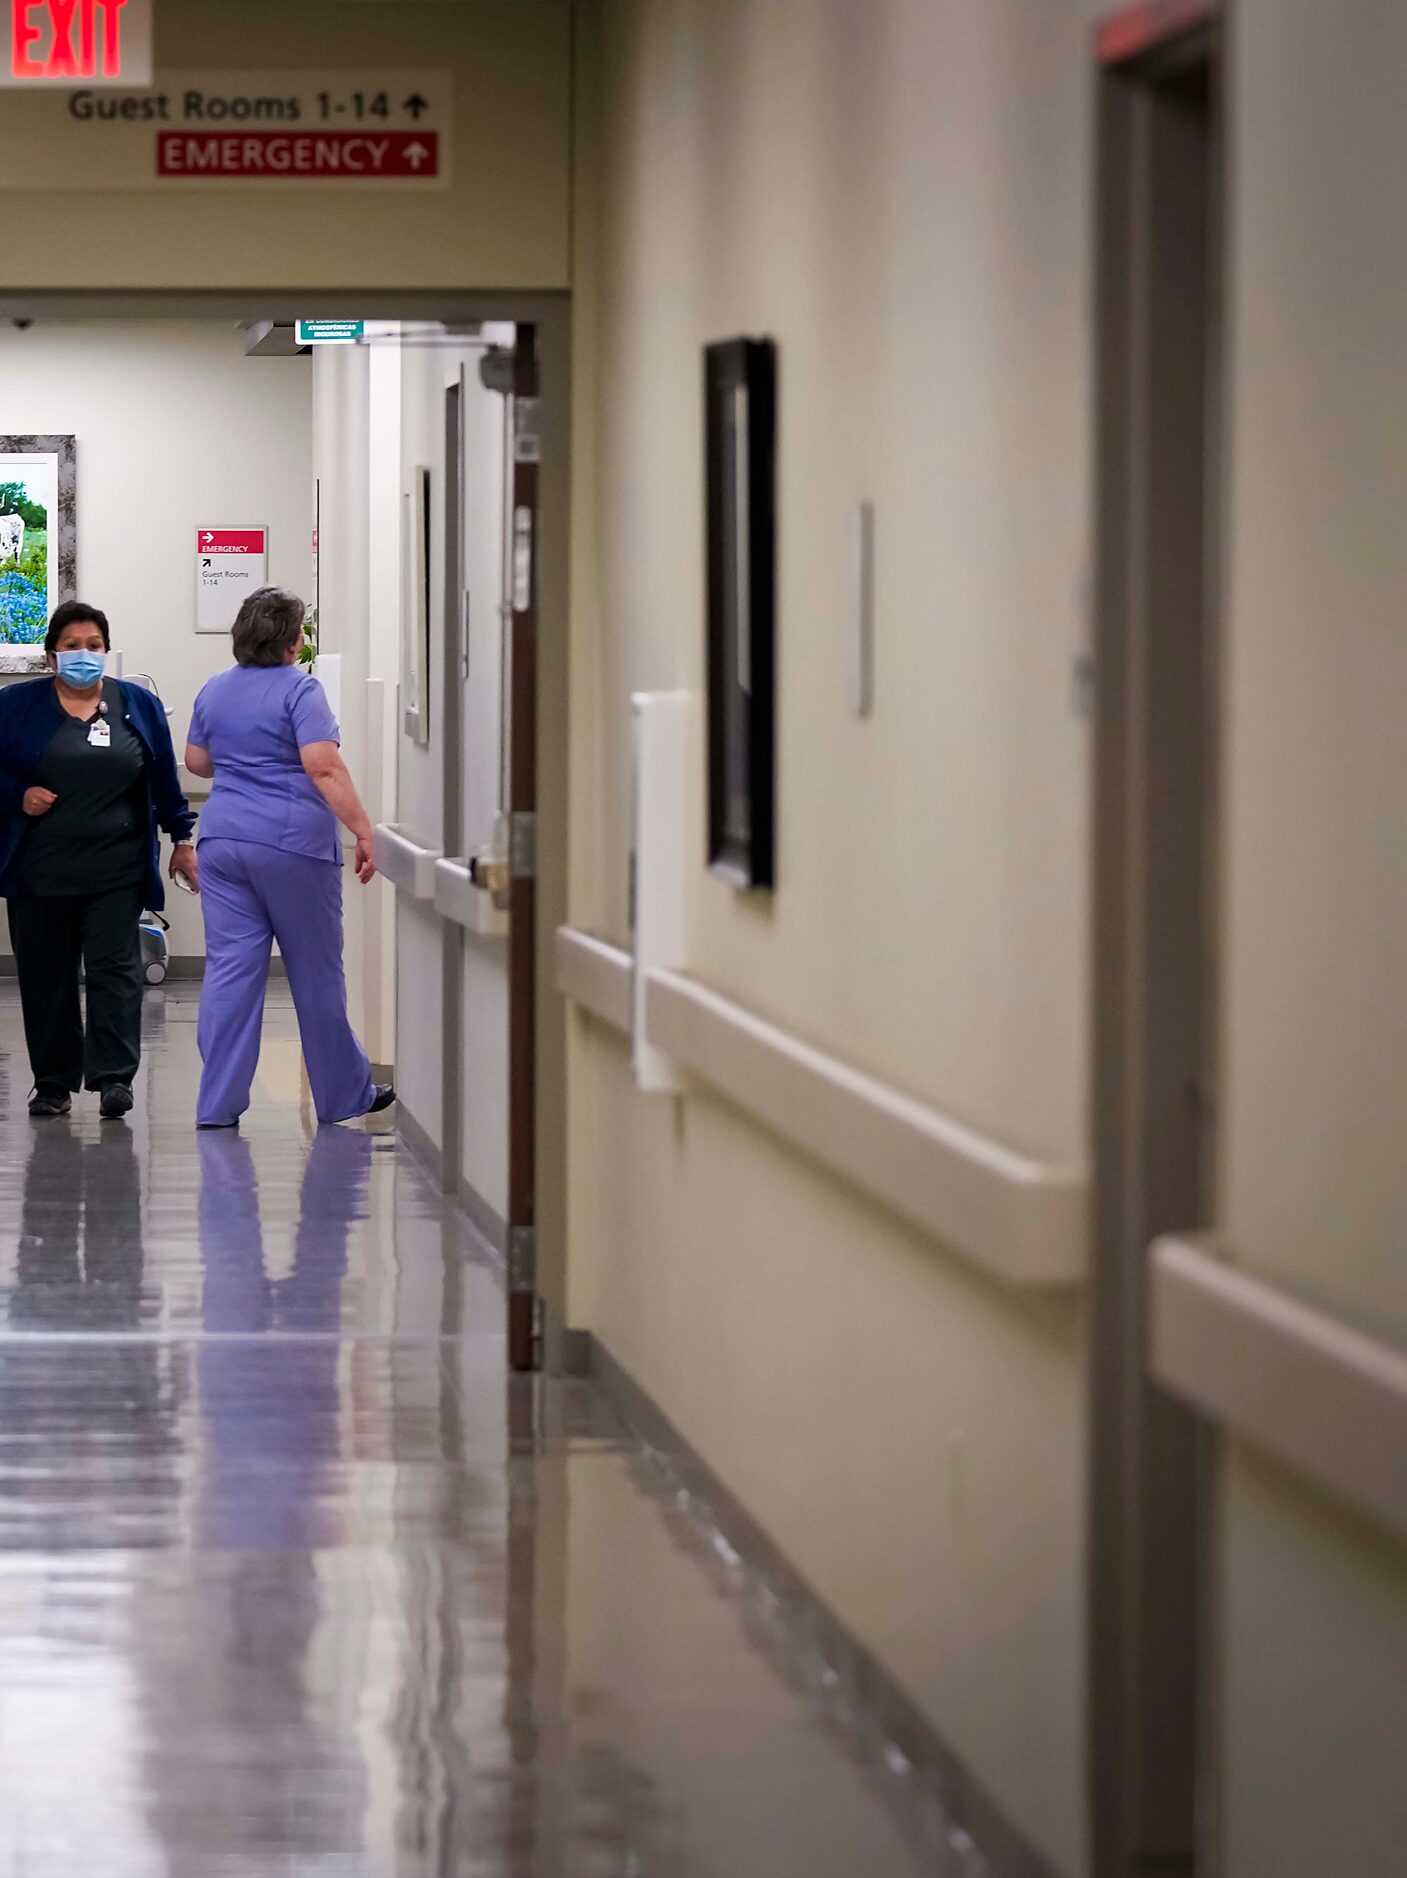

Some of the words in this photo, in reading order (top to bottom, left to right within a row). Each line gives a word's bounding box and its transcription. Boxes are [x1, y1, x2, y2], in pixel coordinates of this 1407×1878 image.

[12, 0, 129, 79] EXIT
[68, 90, 171, 121] Guest
[183, 91, 301, 121] Rooms
[316, 92, 390, 120] 1-14
[163, 137, 391, 170] EMERGENCY
